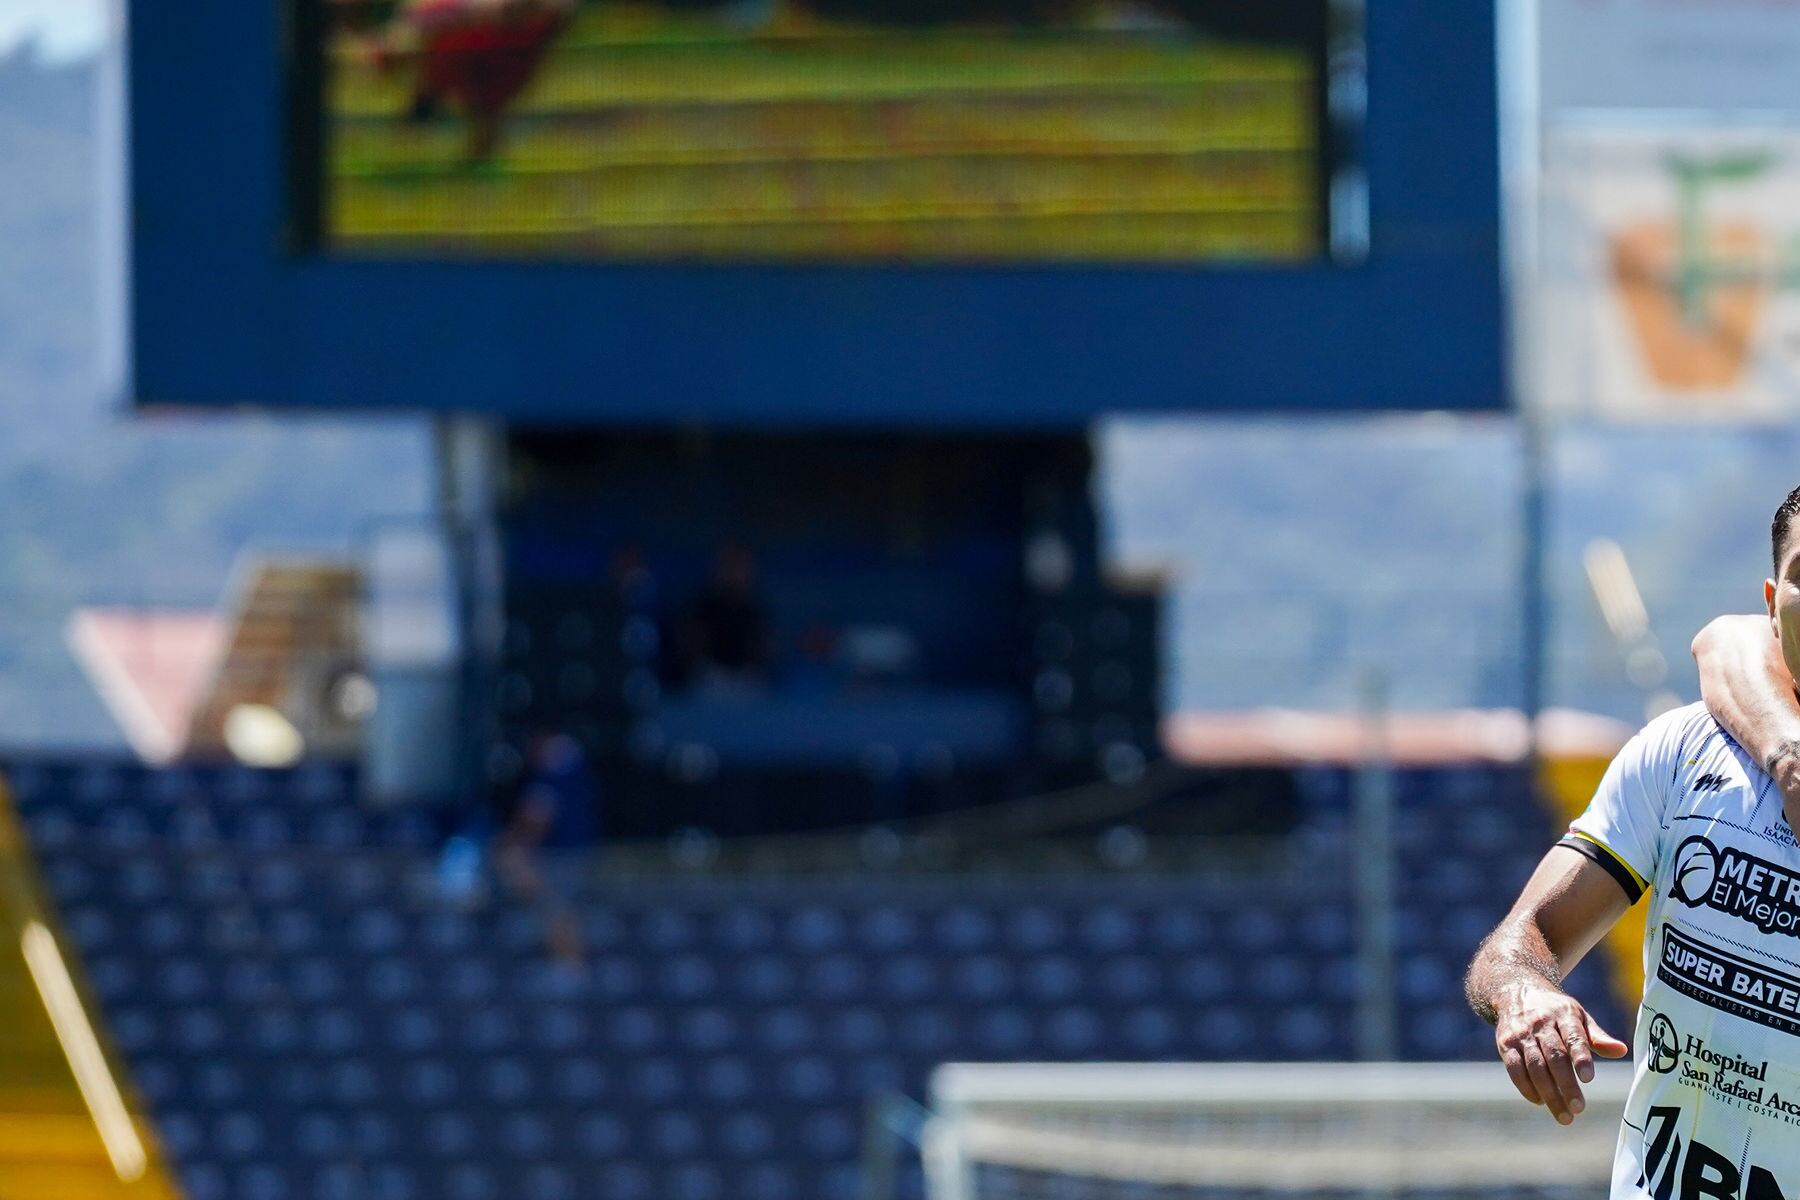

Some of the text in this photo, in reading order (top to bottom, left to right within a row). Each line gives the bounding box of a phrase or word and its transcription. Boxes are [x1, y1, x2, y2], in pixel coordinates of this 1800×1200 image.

[1711, 881, 1729, 906] El
[1665, 941, 1725, 987] SUPER
[1684, 1034, 1768, 1082] Hospital
[1678, 1077, 1733, 1105] GUANACASTE
[1747, 1104, 1779, 1120] COSTA
[1681, 1061, 1710, 1084] San
[1712, 1071, 1764, 1105] Rafael
